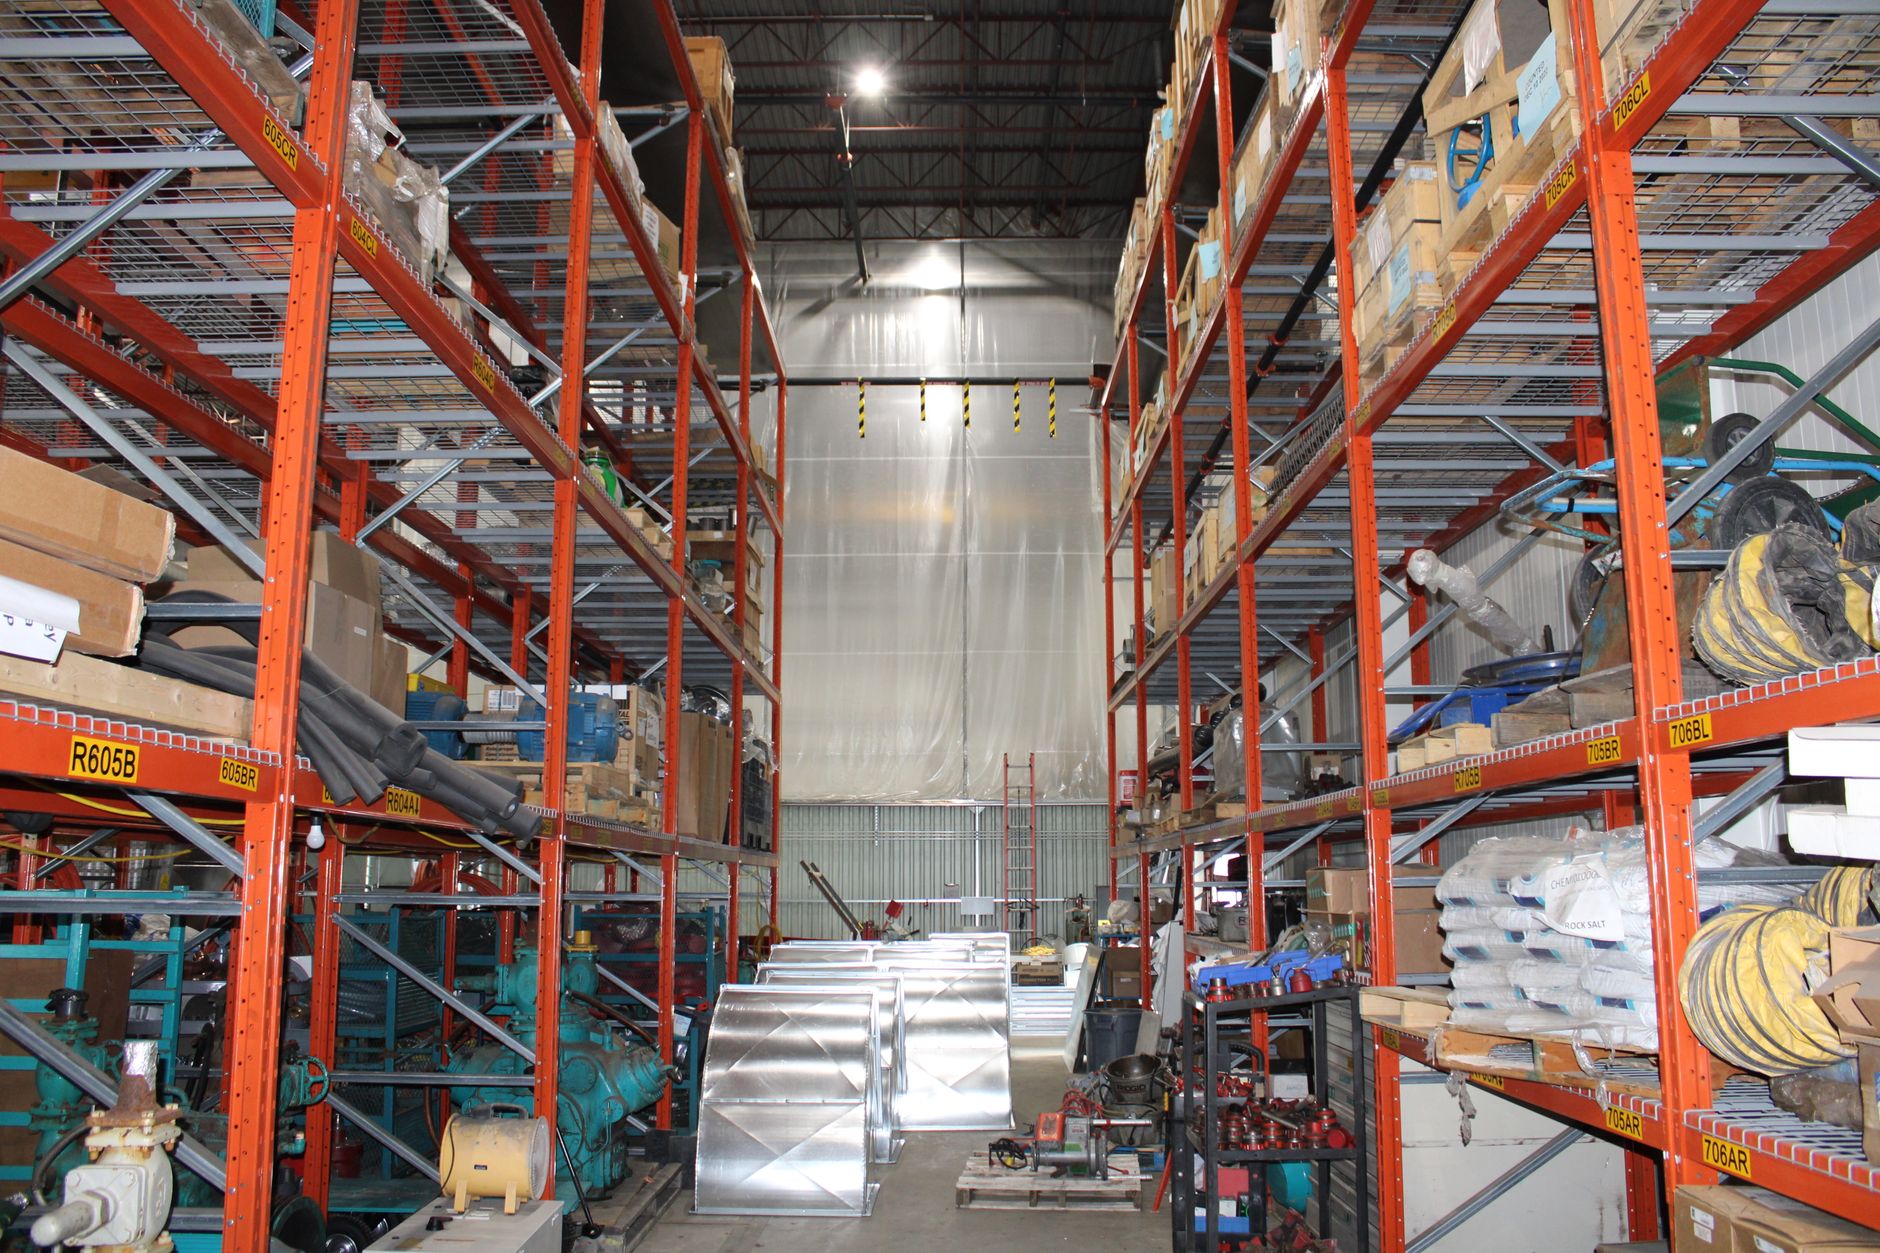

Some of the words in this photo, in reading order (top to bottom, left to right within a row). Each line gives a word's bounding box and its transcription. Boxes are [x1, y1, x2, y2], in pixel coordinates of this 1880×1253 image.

[1614, 80, 1649, 126] 706CL
[264, 118, 296, 166] 605CR
[1546, 163, 1576, 206] 705CR
[352, 220, 377, 256] 604CL
[1671, 718, 1709, 745] 706BL
[71, 741, 136, 779] R605B
[1588, 739, 1620, 763] 705BR
[221, 760, 256, 788] 605BR
[1454, 766, 1480, 791] R705B
[1564, 921, 1586, 930] ROCK
[1587, 920, 1606, 929] SALT
[1607, 1106, 1641, 1137] 705AR
[1704, 1138, 1749, 1175] 706AR
